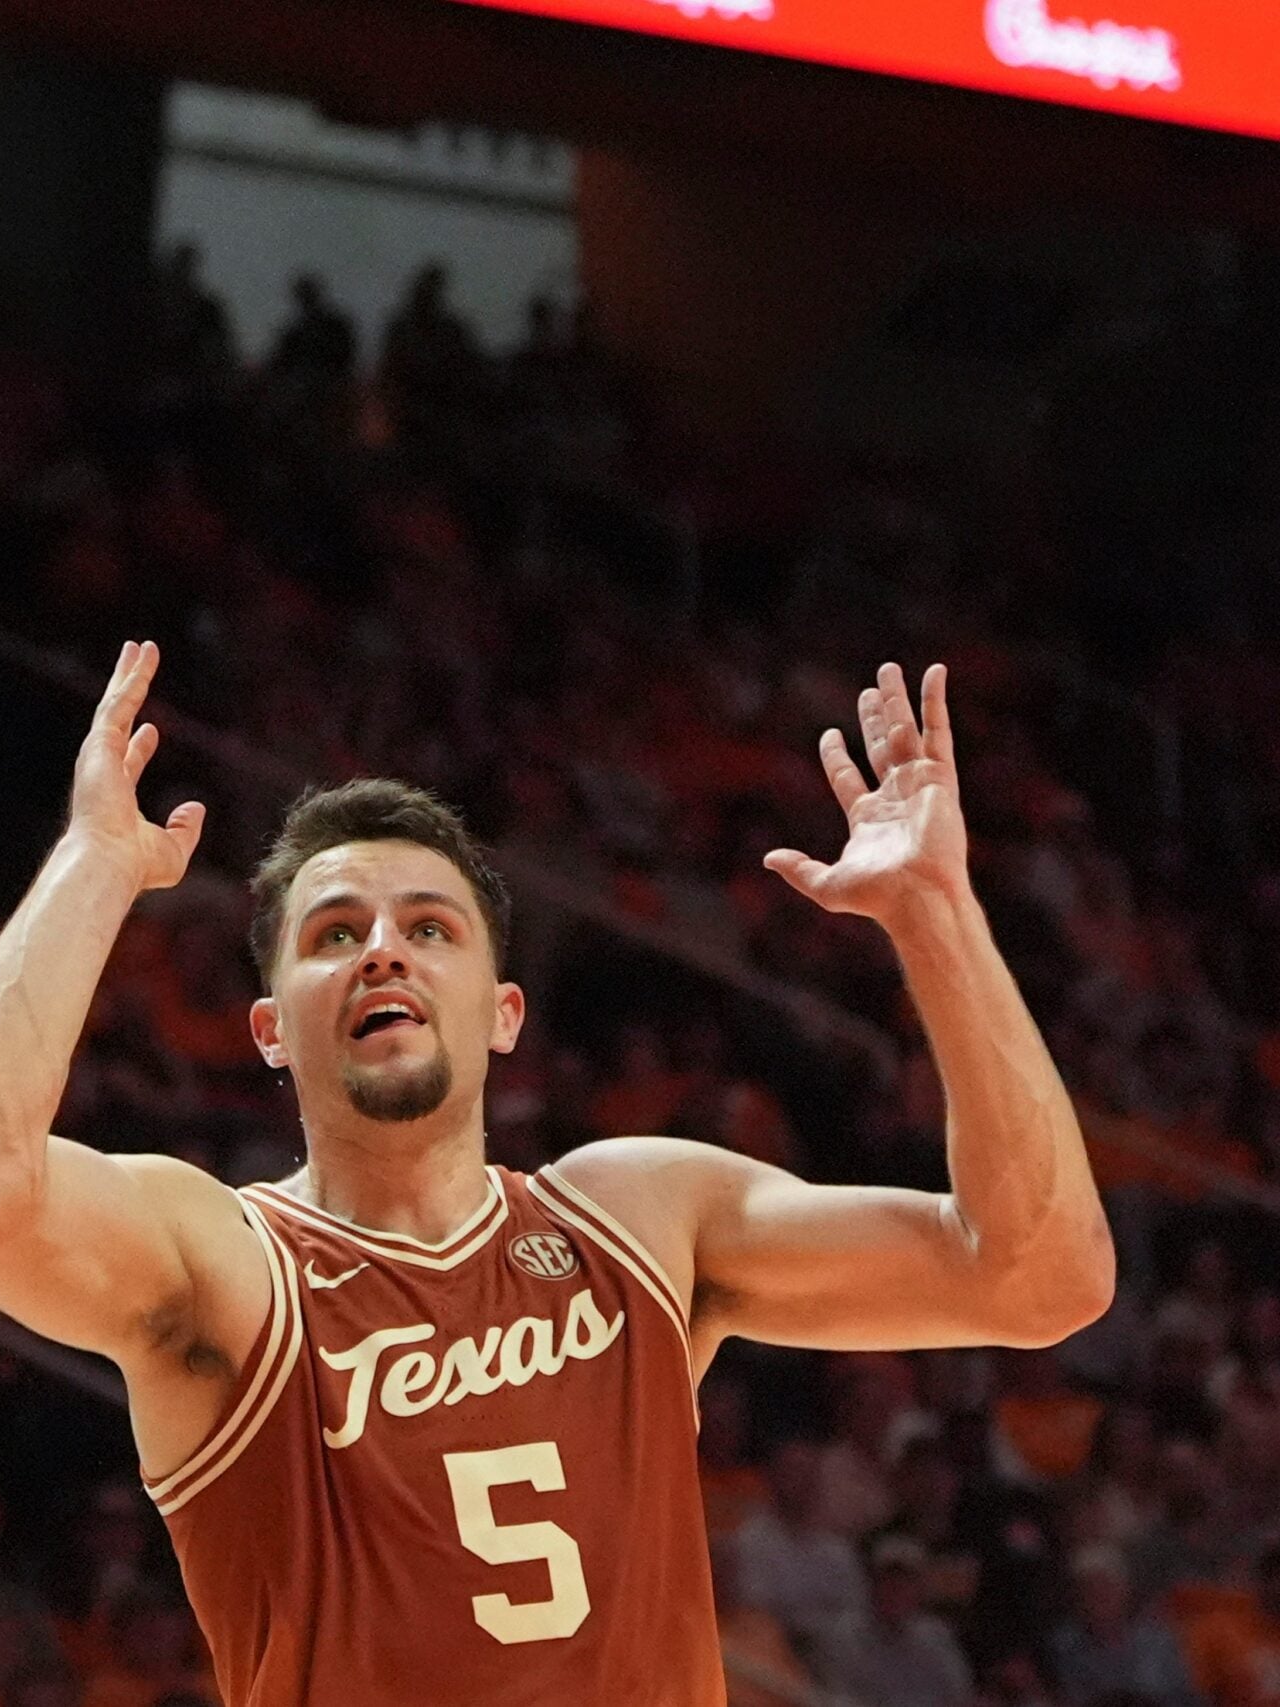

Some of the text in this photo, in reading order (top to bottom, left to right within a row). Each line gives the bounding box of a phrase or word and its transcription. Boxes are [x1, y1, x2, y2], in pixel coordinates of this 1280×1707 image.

[514, 1234, 575, 1277] SEC
[319, 1288, 626, 1450] Texas
[442, 1440, 592, 1646] 5
